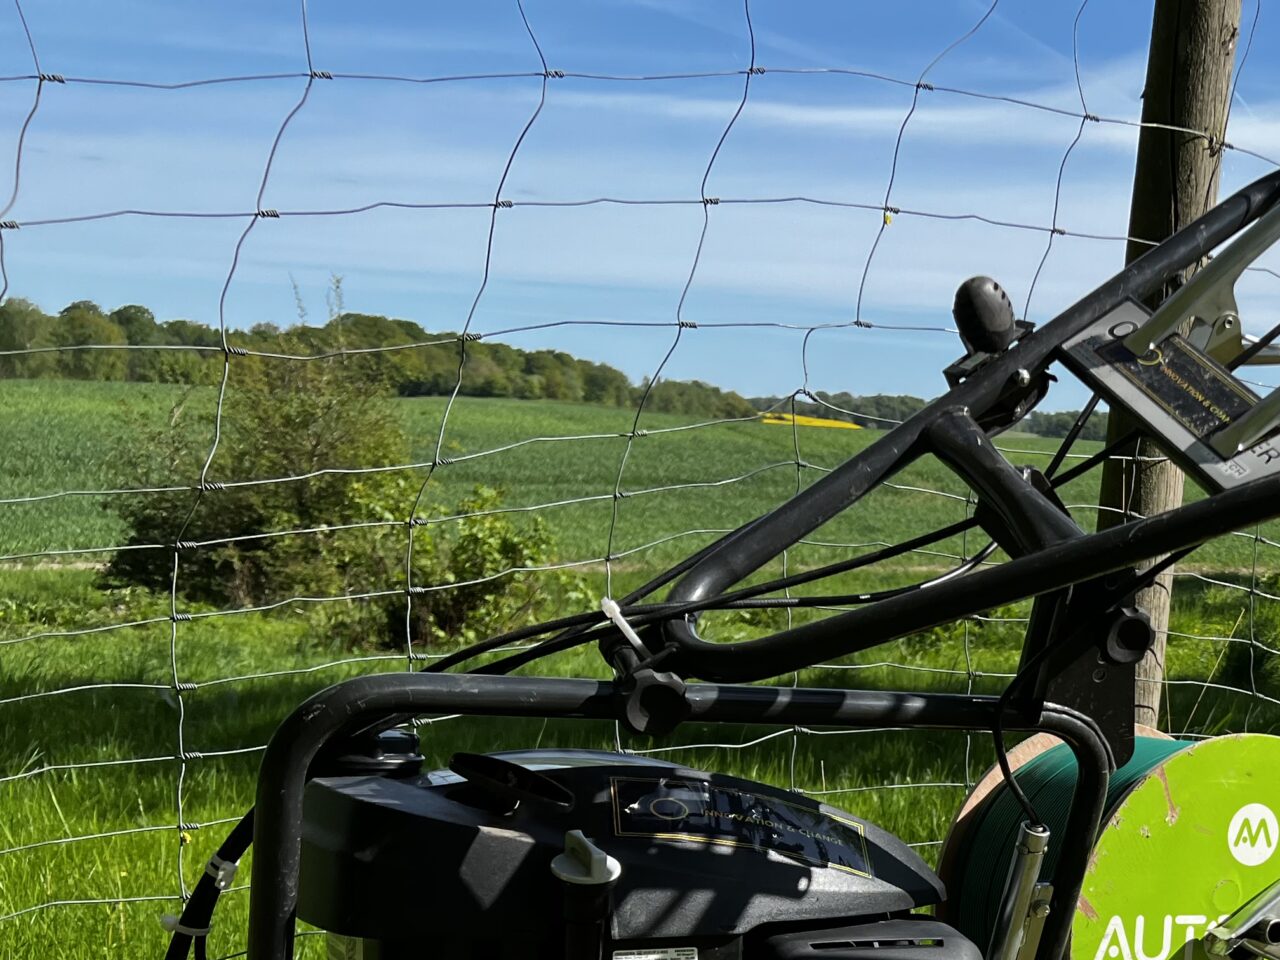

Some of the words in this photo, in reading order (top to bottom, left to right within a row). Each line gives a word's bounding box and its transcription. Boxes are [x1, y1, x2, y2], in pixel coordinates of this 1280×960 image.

[701, 808, 783, 830] INNOVATION
[786, 825, 796, 833] &
[798, 829, 844, 846] CHANGE
